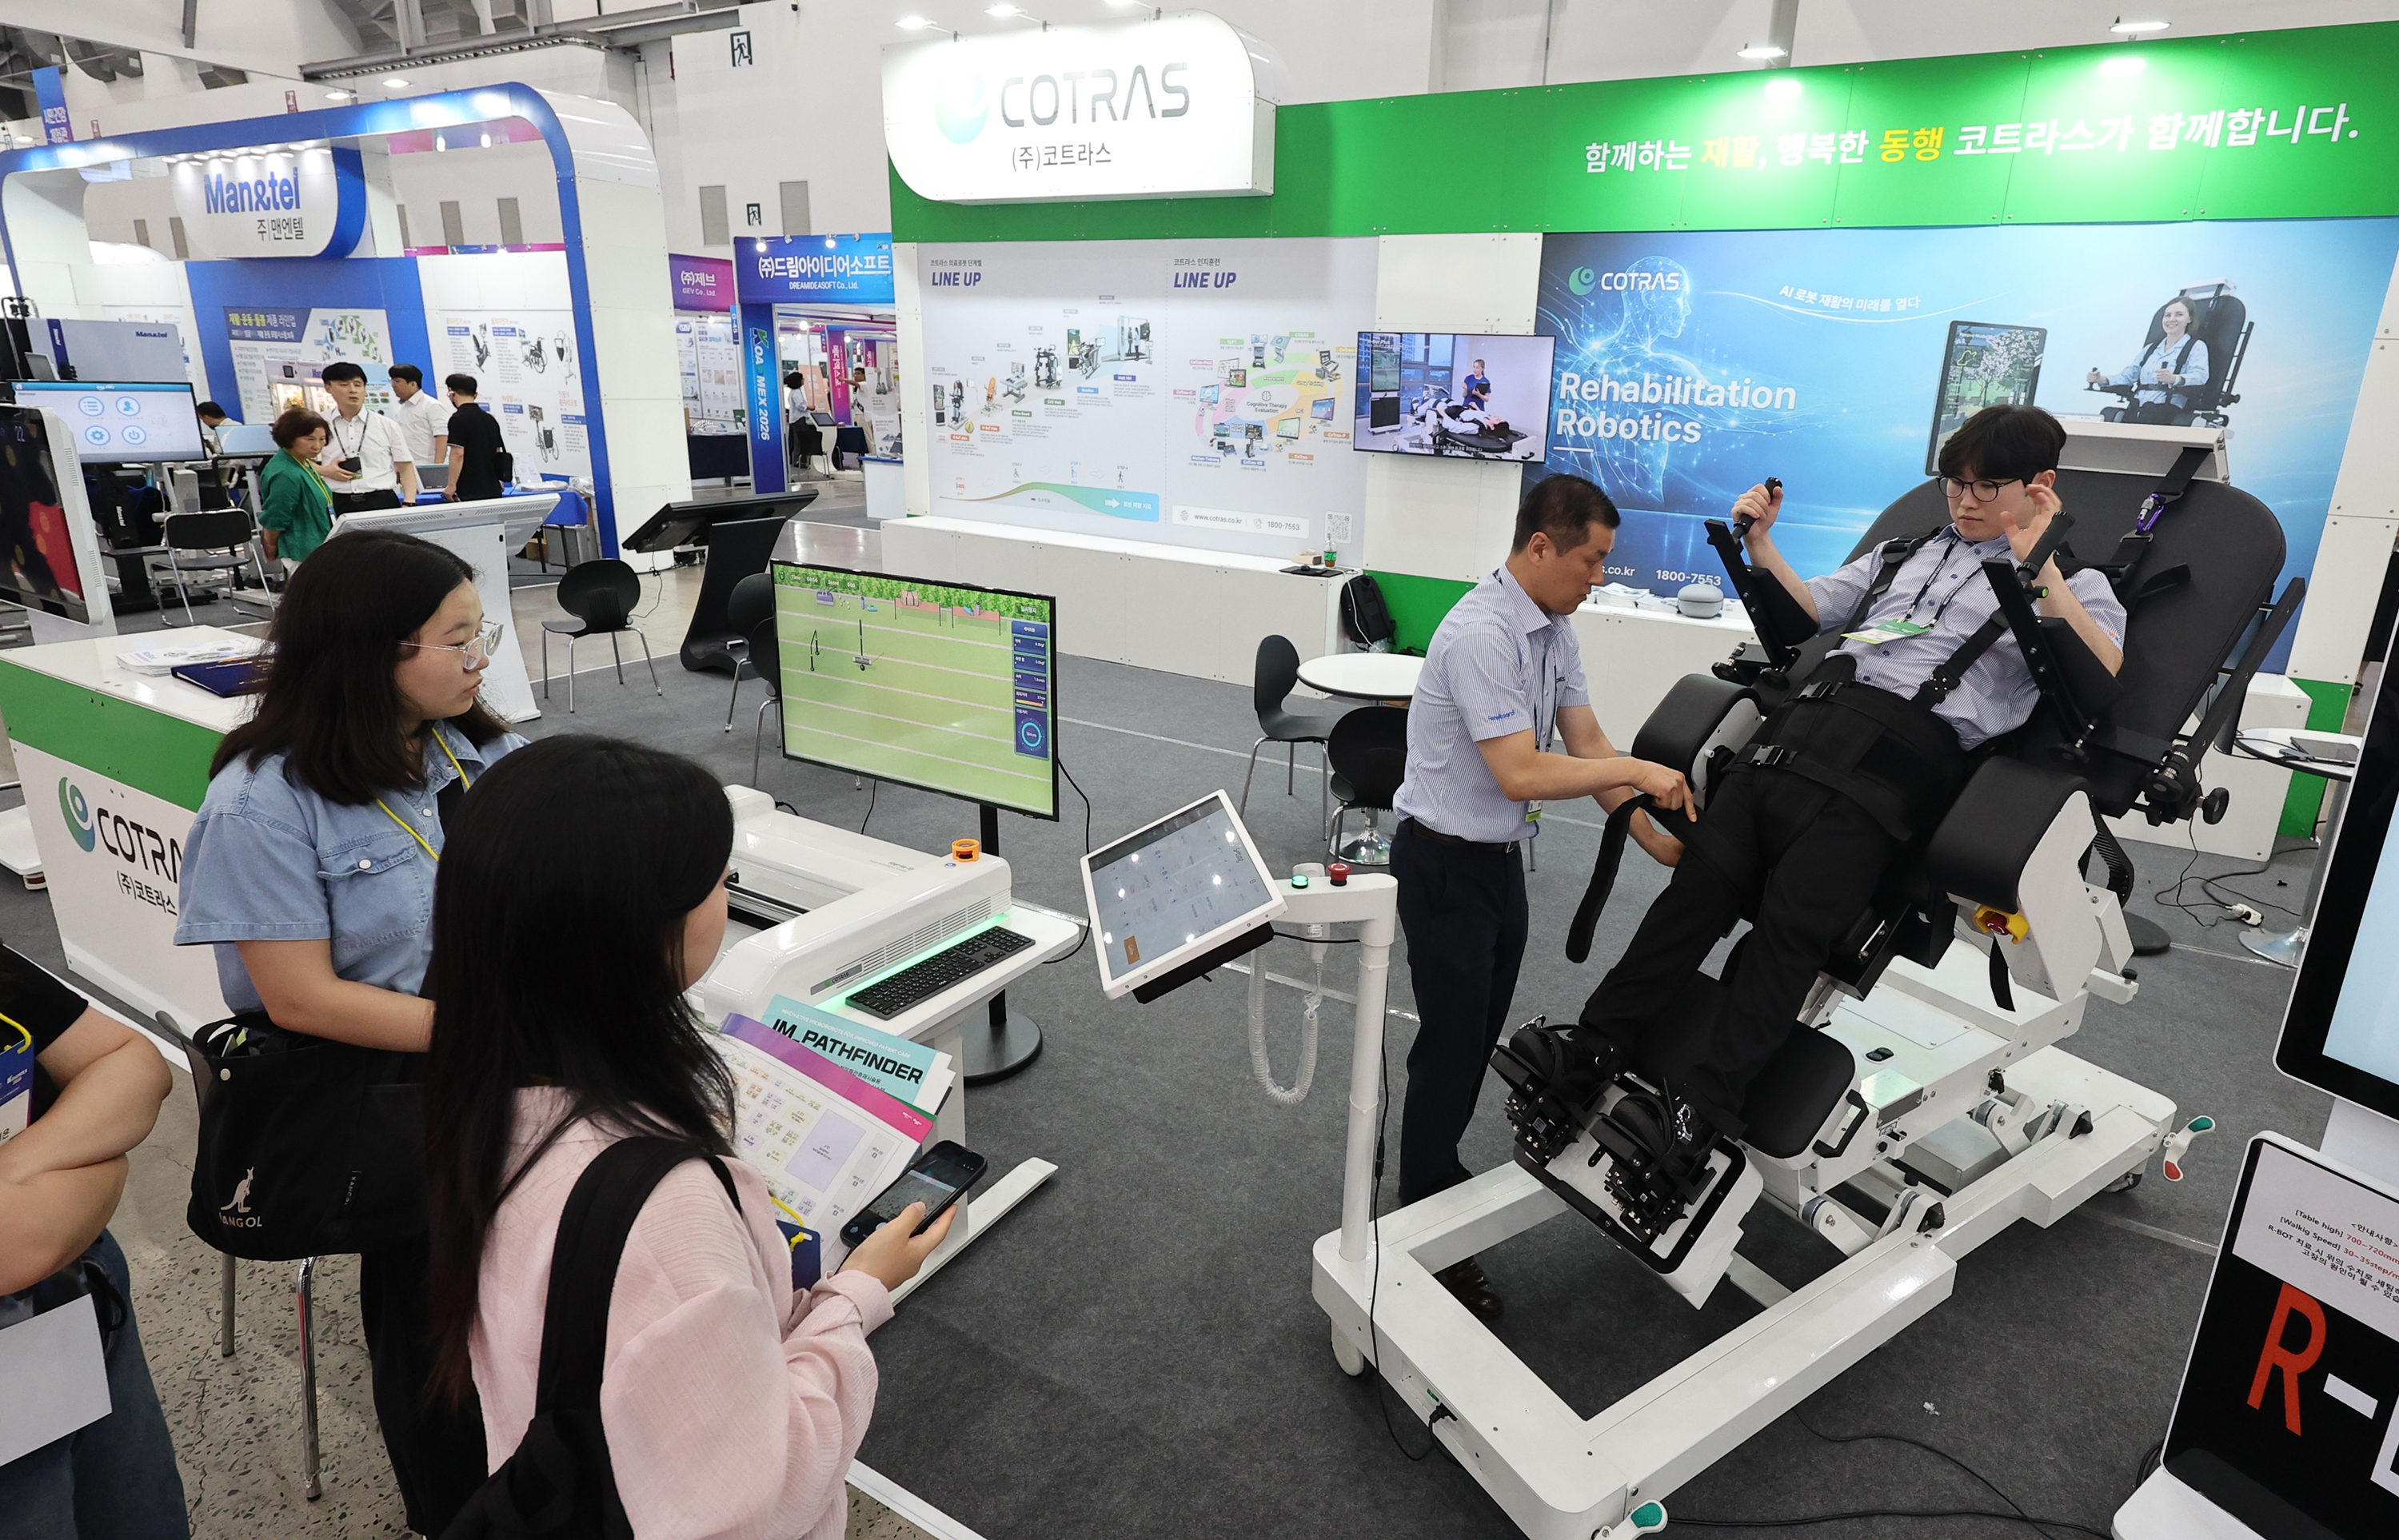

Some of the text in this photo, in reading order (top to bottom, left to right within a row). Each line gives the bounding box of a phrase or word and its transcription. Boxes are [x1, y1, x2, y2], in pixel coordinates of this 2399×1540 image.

[1001, 62, 1191, 129] COTRAS
[1584, 140, 1693, 174] 함께하는
[1776, 129, 1870, 166] 행복한
[1878, 126, 1944, 162] 동행
[1953, 115, 2135, 158] 코트라스가
[2146, 102, 2360, 152] 함께합니다.
[1012, 142, 1112, 173] (주)코트라스
[204, 166, 301, 214] Man&tel
[758, 254, 892, 280] (주)드림아이디어소프트
[1197, 257, 1220, 266] 인지훈련
[681, 270, 717, 287] (주)제브
[788, 281, 836, 290] DREAMIDEASOFT
[932, 272, 982, 286] LINE UP
[1174, 272, 1236, 288] LINE UP
[1600, 272, 1681, 292] COTRAS
[1779, 285, 1921, 312] AI 로봇 재활의 미래를 열다
[1559, 371, 1798, 411] Rehabilitation
[757, 406, 770, 441] 2026
[1555, 409, 1702, 445] Robotics
[1194, 513, 1243, 525] www.cotras.co.kr
[1267, 521, 1300, 531] 1800-7553
[1655, 569, 1722, 586] 1800-7553
[97, 808, 182, 884] COTRA
[117, 870, 178, 916] (주)코트라스
[832, 971, 850, 983] COTRAS
[781, 1008, 810, 1022] INNOVATIVE
[772, 1019, 924, 1084] IM_PATHFINDER
[2280, 1216, 2311, 1235] [Walkig
[2311, 1232, 2341, 1251] Speed]
[2295, 1210, 2320, 1226] [Table
[2321, 1222, 2344, 1238] high]
[2351, 1223, 2399, 1247] <안내사항>
[2268, 1224, 2293, 1240] R-BOT
[2295, 1238, 2313, 1251] 치료
[2325, 1253, 2345, 1267] 위의
[2345, 1264, 2373, 1281] 수치로
[2301, 1248, 2328, 1266] 고장의
[2329, 1263, 2356, 1281] 원인이
[2358, 1278, 2368, 1287] 될
[2369, 1284, 2380, 1293] 수
